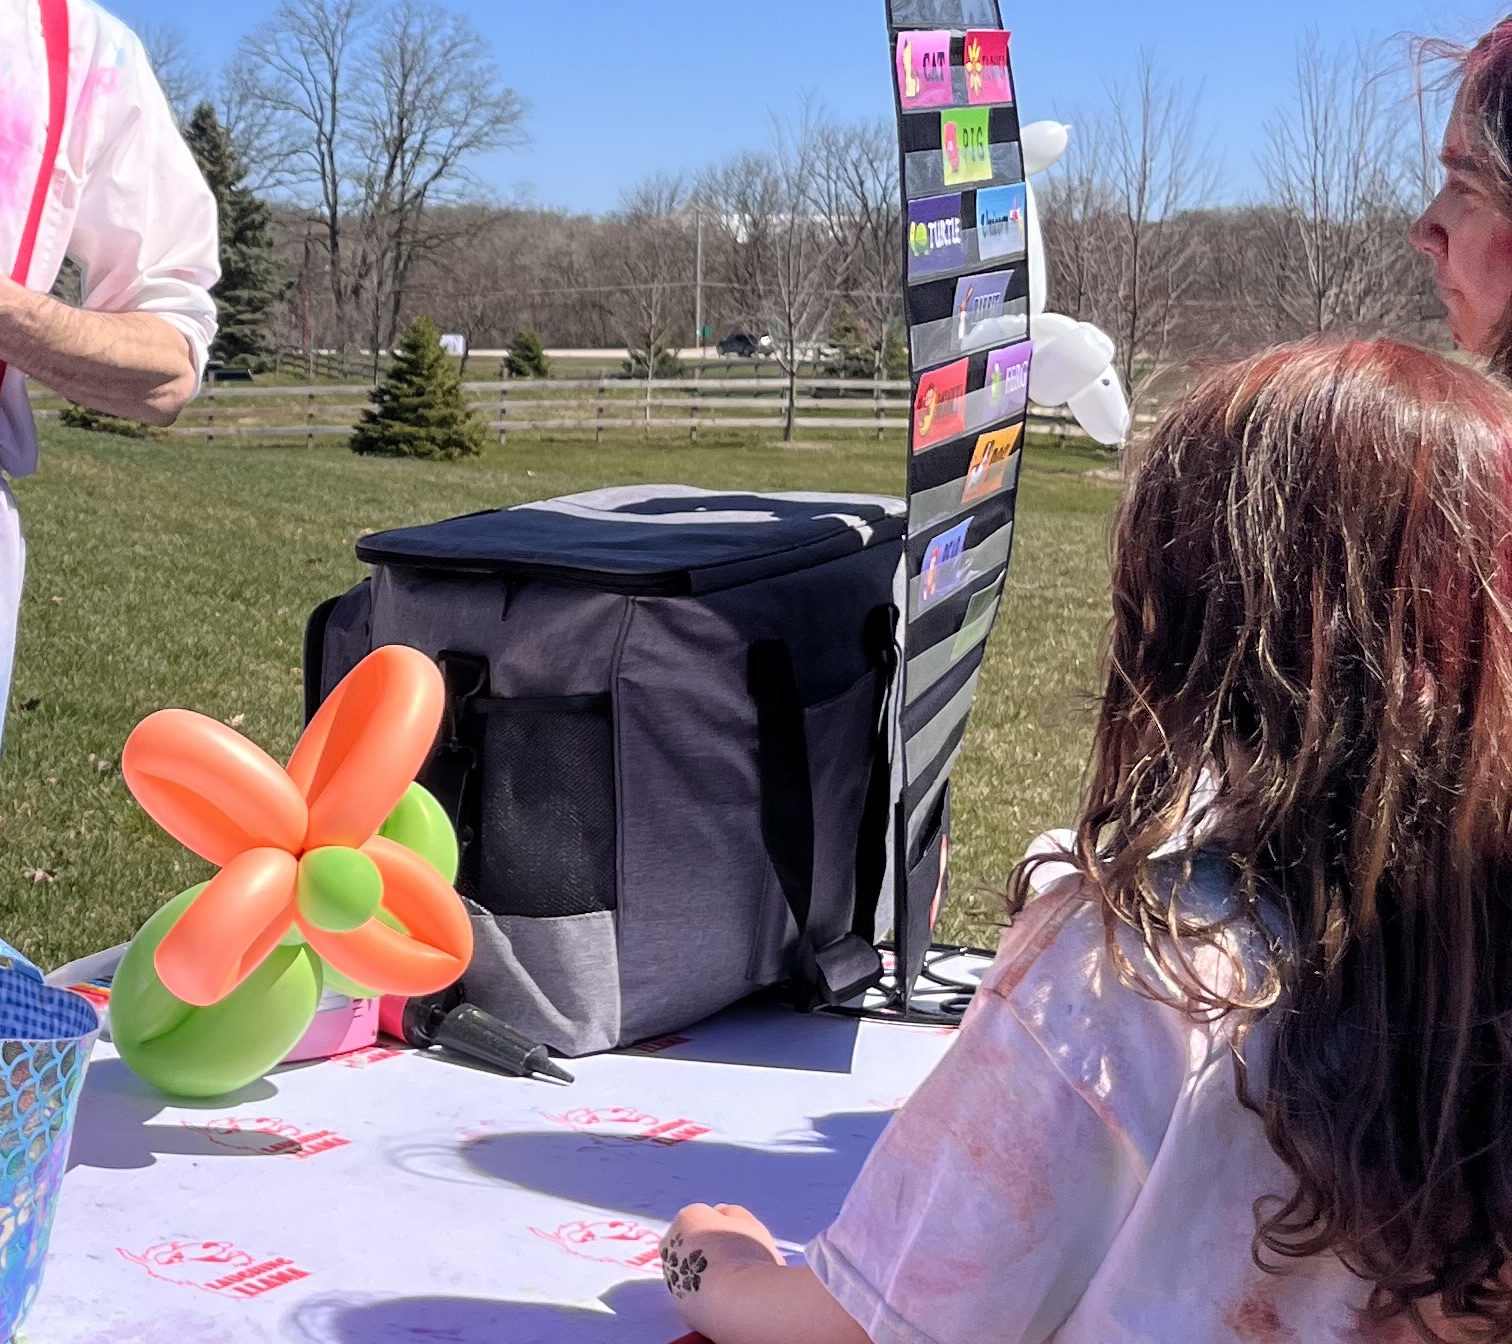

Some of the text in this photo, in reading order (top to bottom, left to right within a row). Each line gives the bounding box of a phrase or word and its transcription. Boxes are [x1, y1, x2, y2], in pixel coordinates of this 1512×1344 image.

[923, 51, 945, 81] CAT
[927, 217, 962, 249] TURTLE
[232, 1268, 312, 1297] LLAMA
